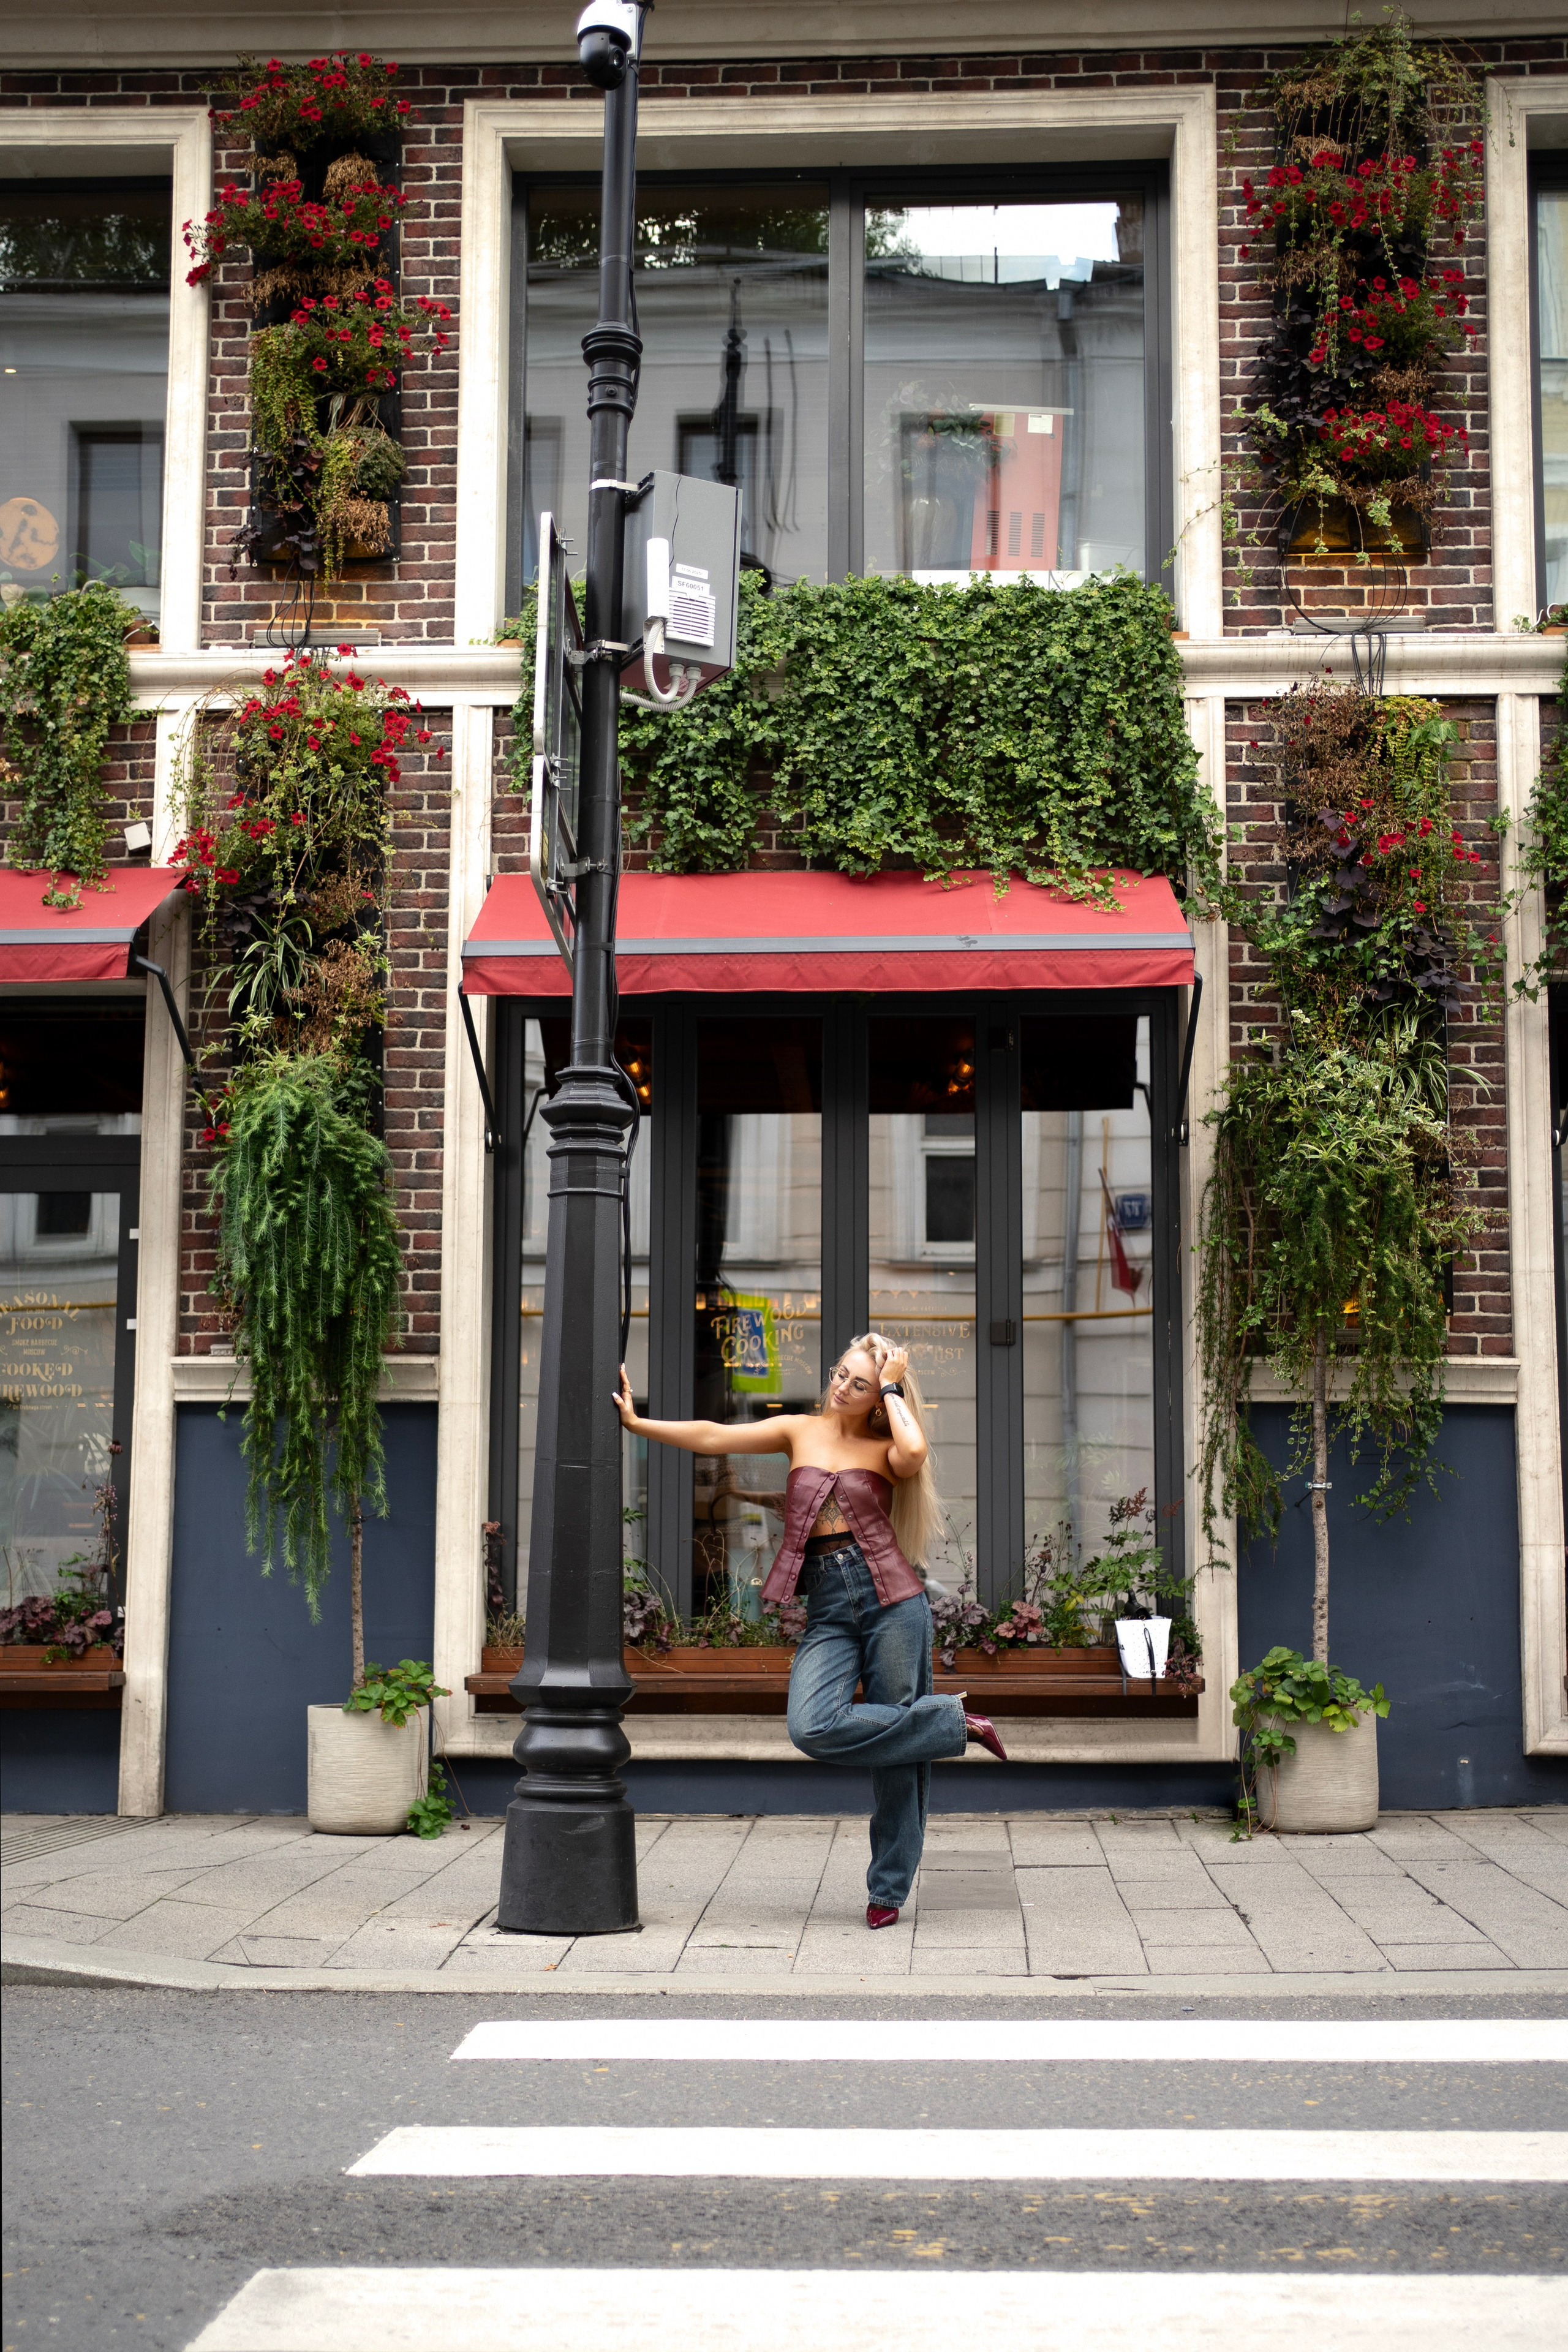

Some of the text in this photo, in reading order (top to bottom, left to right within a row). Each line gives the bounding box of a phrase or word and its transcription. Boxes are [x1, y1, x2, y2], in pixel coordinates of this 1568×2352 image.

[677, 580, 704, 592] SF60051
[0, 1290, 80, 1322] EASONAL
[6, 1317, 62, 1335] FOOD
[710, 1302, 807, 1340] FIREWOOD
[879, 1321, 970, 1338] EXTENSIVE
[721, 1321, 804, 1363] COOKING
[934, 1346, 964, 1363] LIST
[794, 1357, 813, 1375] MOSCOW
[0, 1384, 83, 1403] REWOOD
